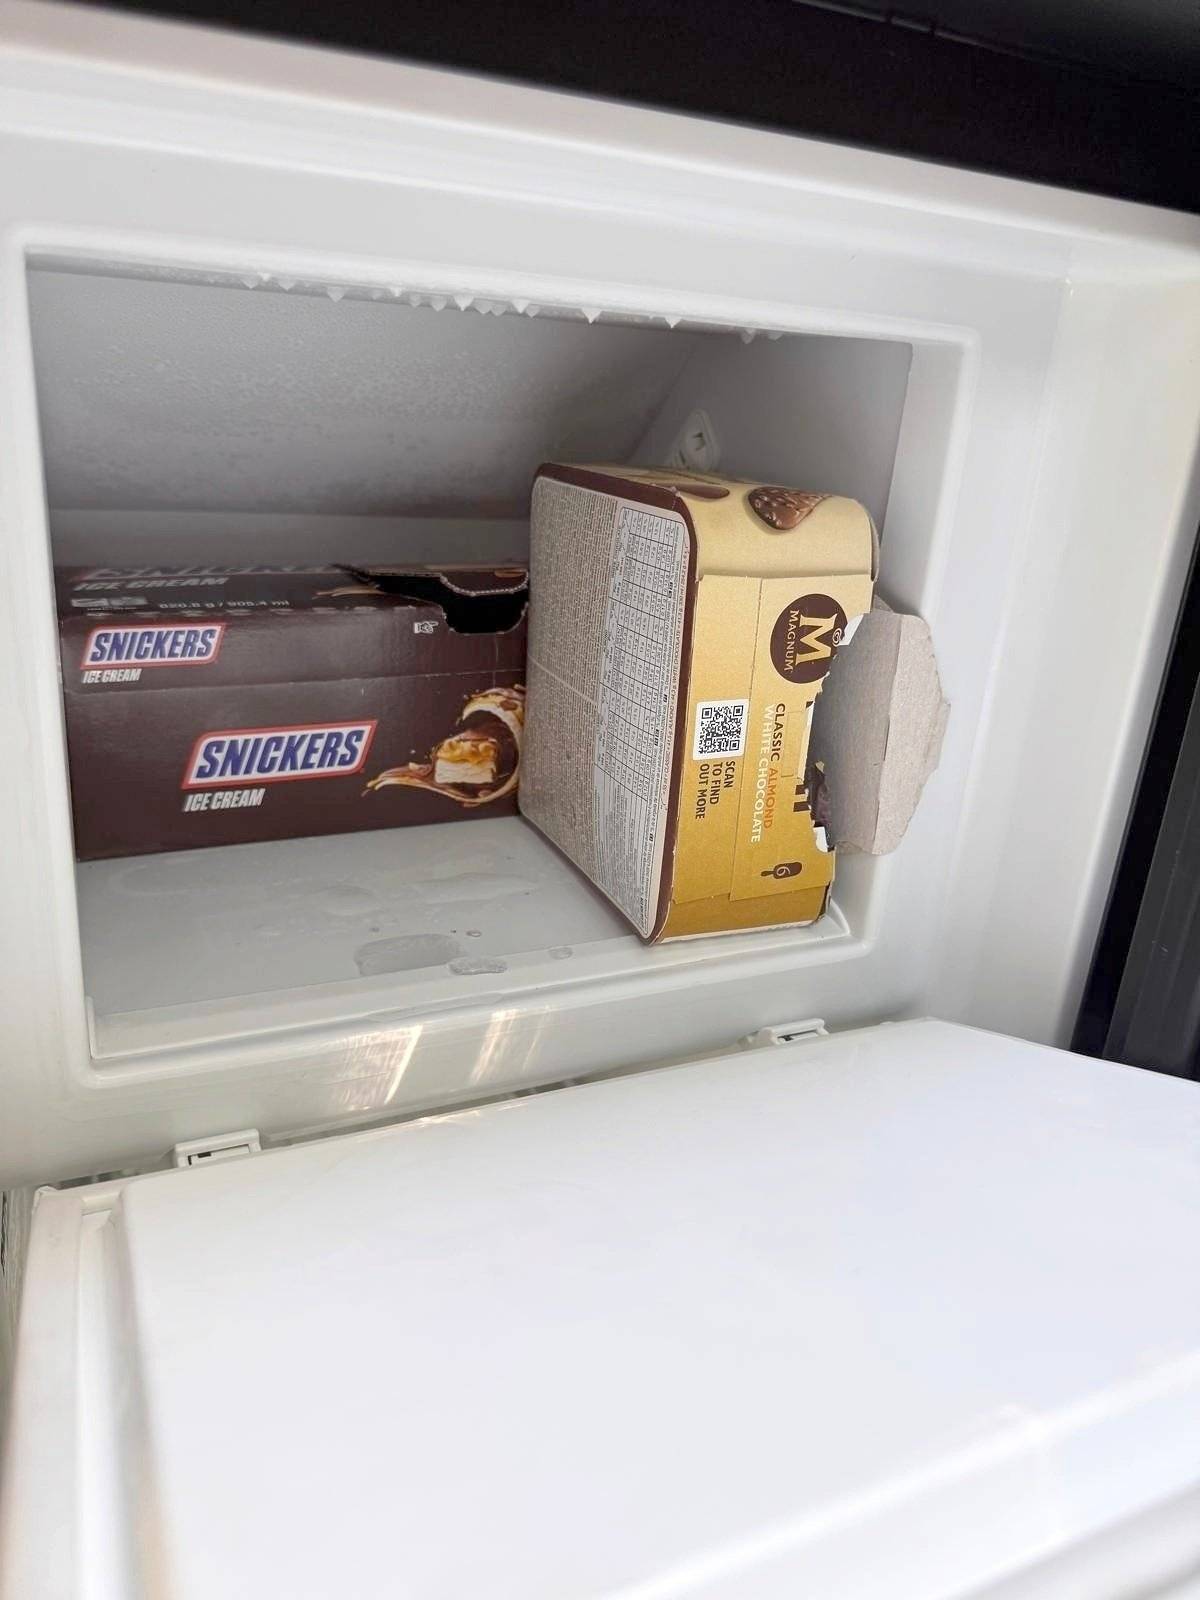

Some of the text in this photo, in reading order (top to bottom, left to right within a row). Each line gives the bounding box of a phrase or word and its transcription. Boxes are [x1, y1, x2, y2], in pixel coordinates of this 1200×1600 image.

[90, 629, 217, 662] SNICKERS
[783, 610, 799, 672] MAGNUM
[83, 669, 141, 684] ICE CREAM
[196, 730, 365, 778] SNICKERS
[723, 760, 736, 788] SCAN
[751, 704, 776, 843] WHITE CHOCOLATE
[763, 703, 786, 829] CLASSIC ALMOND
[184, 789, 266, 812] ICE CREAM
[695, 764, 710, 820] OUT MORE
[709, 762, 723, 805] TO FIND
[777, 865, 791, 876] 6
